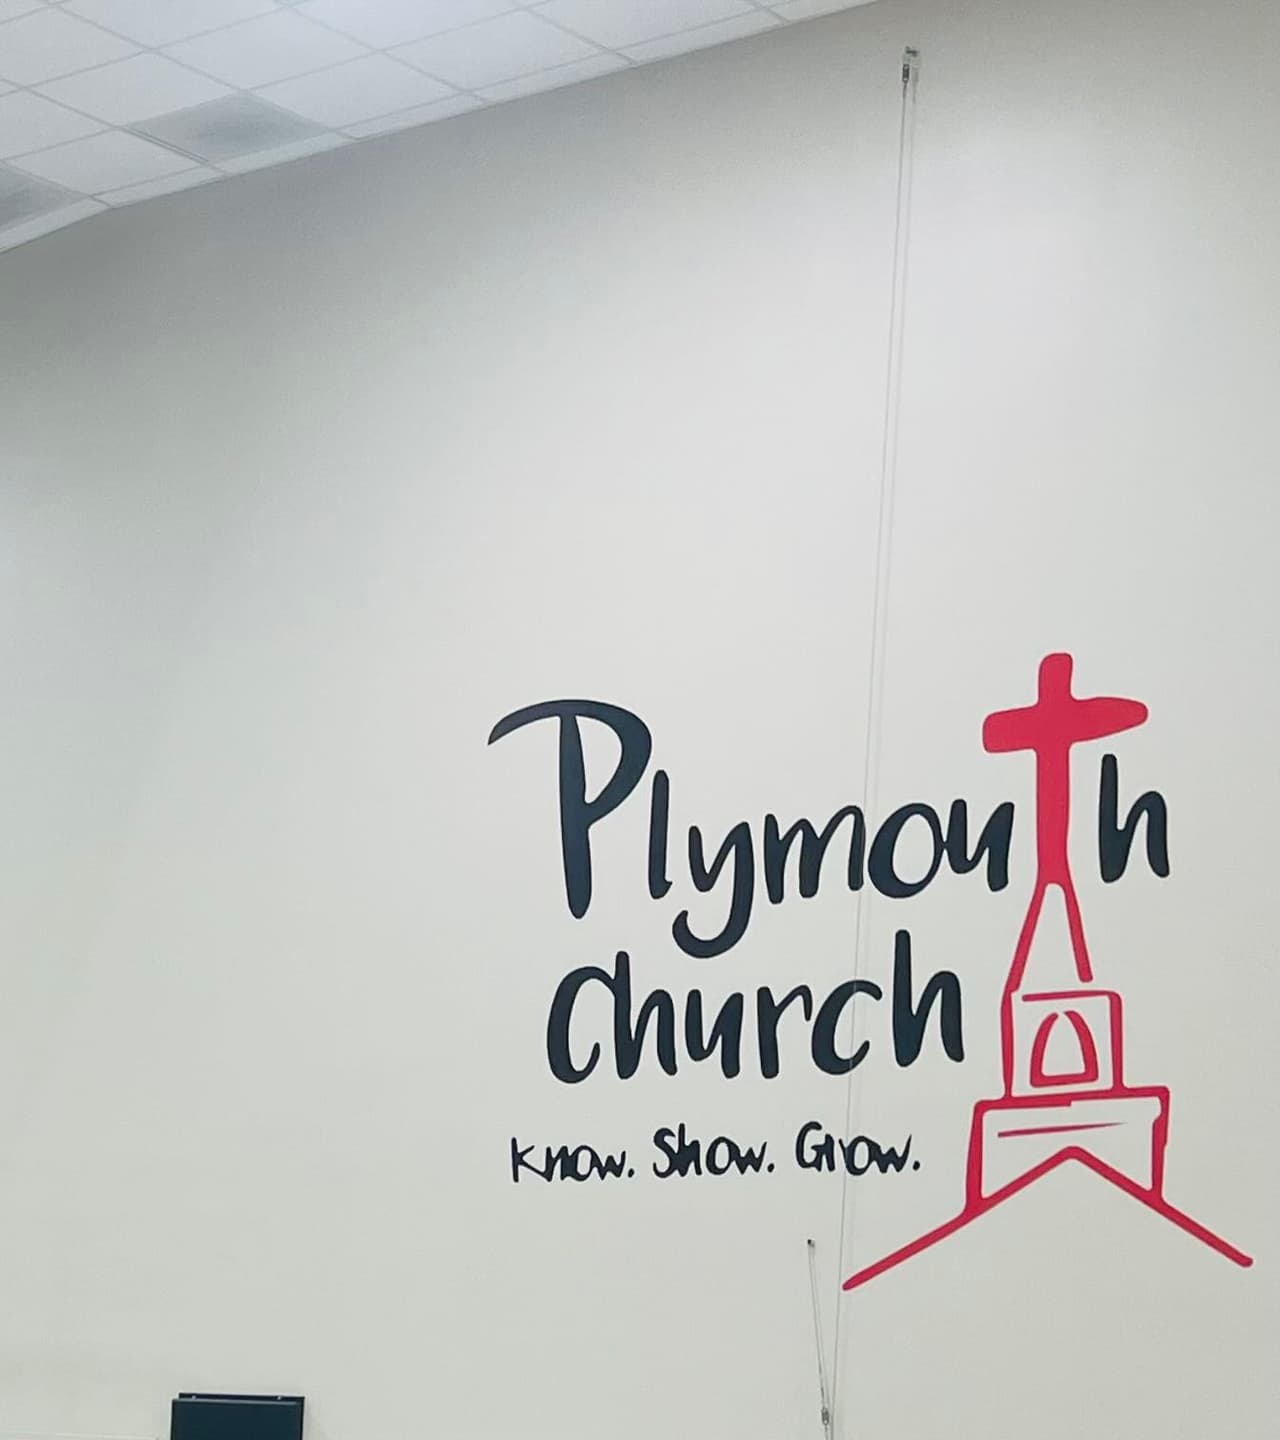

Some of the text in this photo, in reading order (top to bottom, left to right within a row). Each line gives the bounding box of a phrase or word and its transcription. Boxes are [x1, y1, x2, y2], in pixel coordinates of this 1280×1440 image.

[488, 653, 1169, 958] Plymouth
[653, 1122, 775, 1178] Show.
[795, 1121, 921, 1176] Grow.
